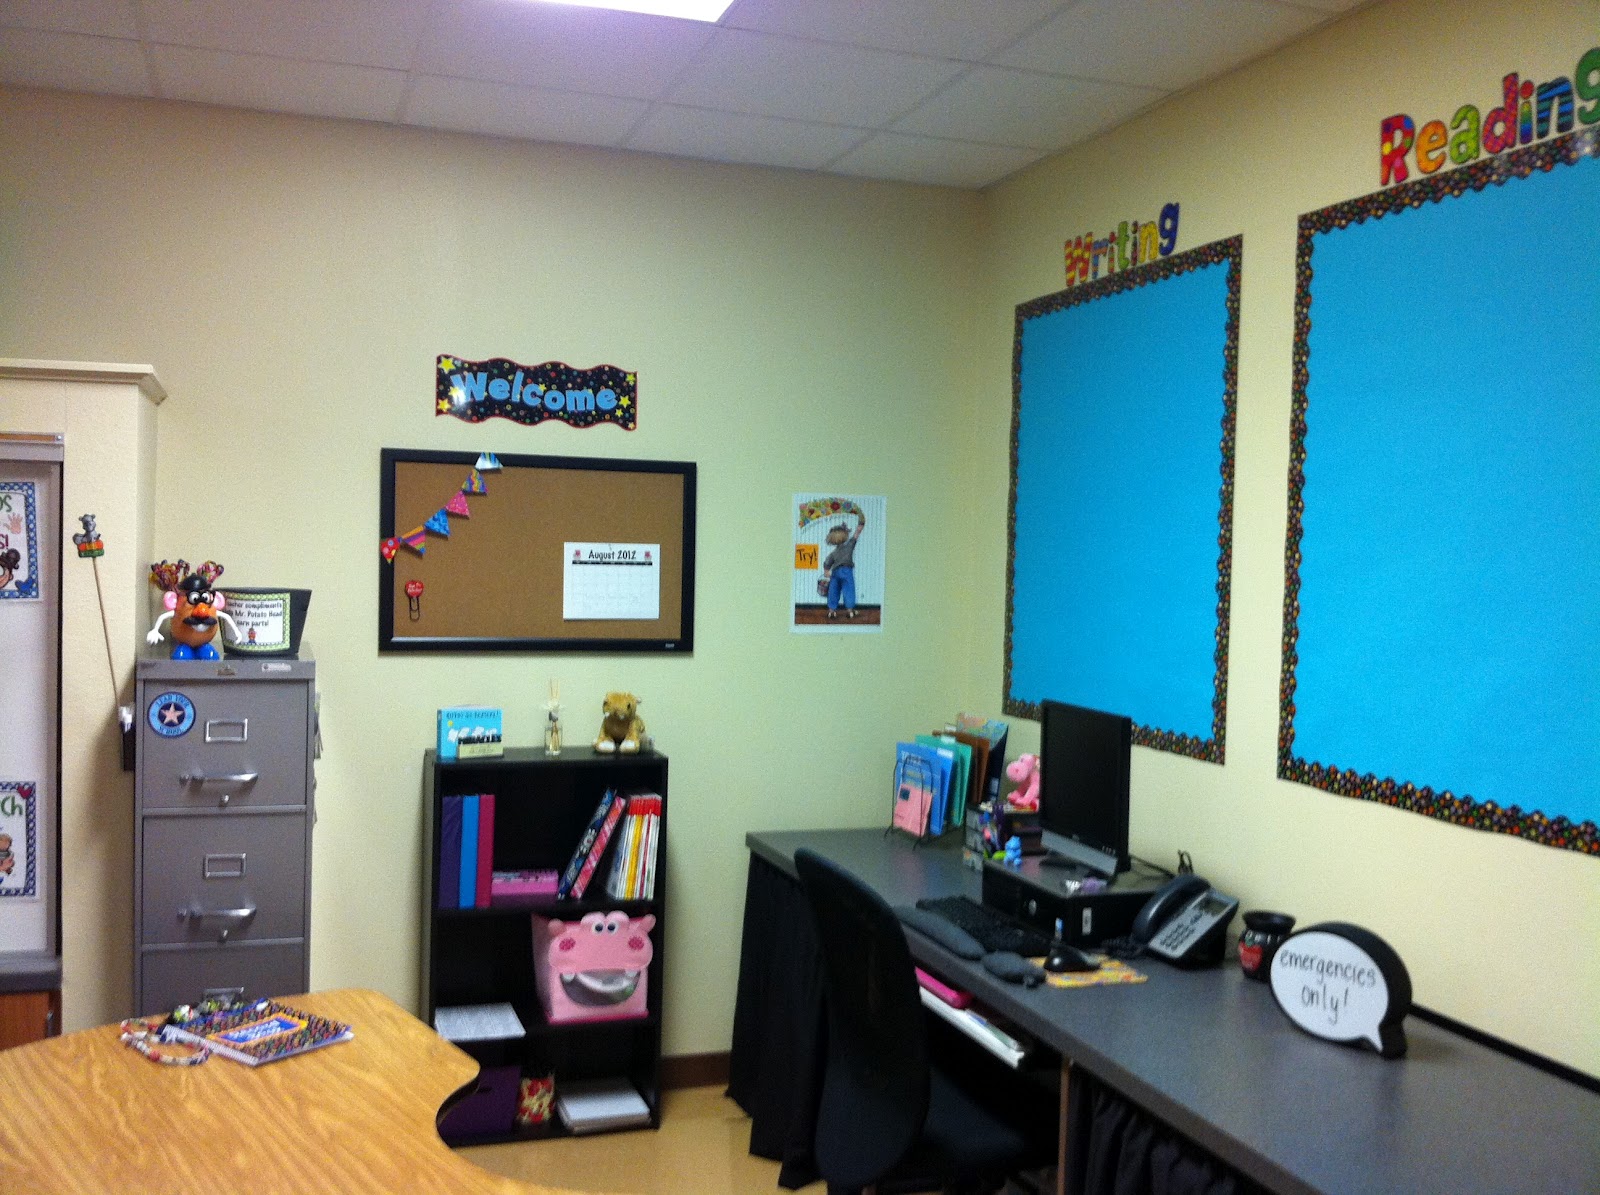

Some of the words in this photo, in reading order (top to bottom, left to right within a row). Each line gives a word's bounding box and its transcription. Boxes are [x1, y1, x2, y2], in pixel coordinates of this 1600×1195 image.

[1380, 46, 1600, 187] Reading
[1064, 202, 1180, 287] Writing
[450, 371, 618, 412] Welcome
[588, 549, 615, 561] August
[617, 550, 637, 560] 2012
[796, 547, 818, 566] Try!
[1279, 949, 1377, 988] emergencies
